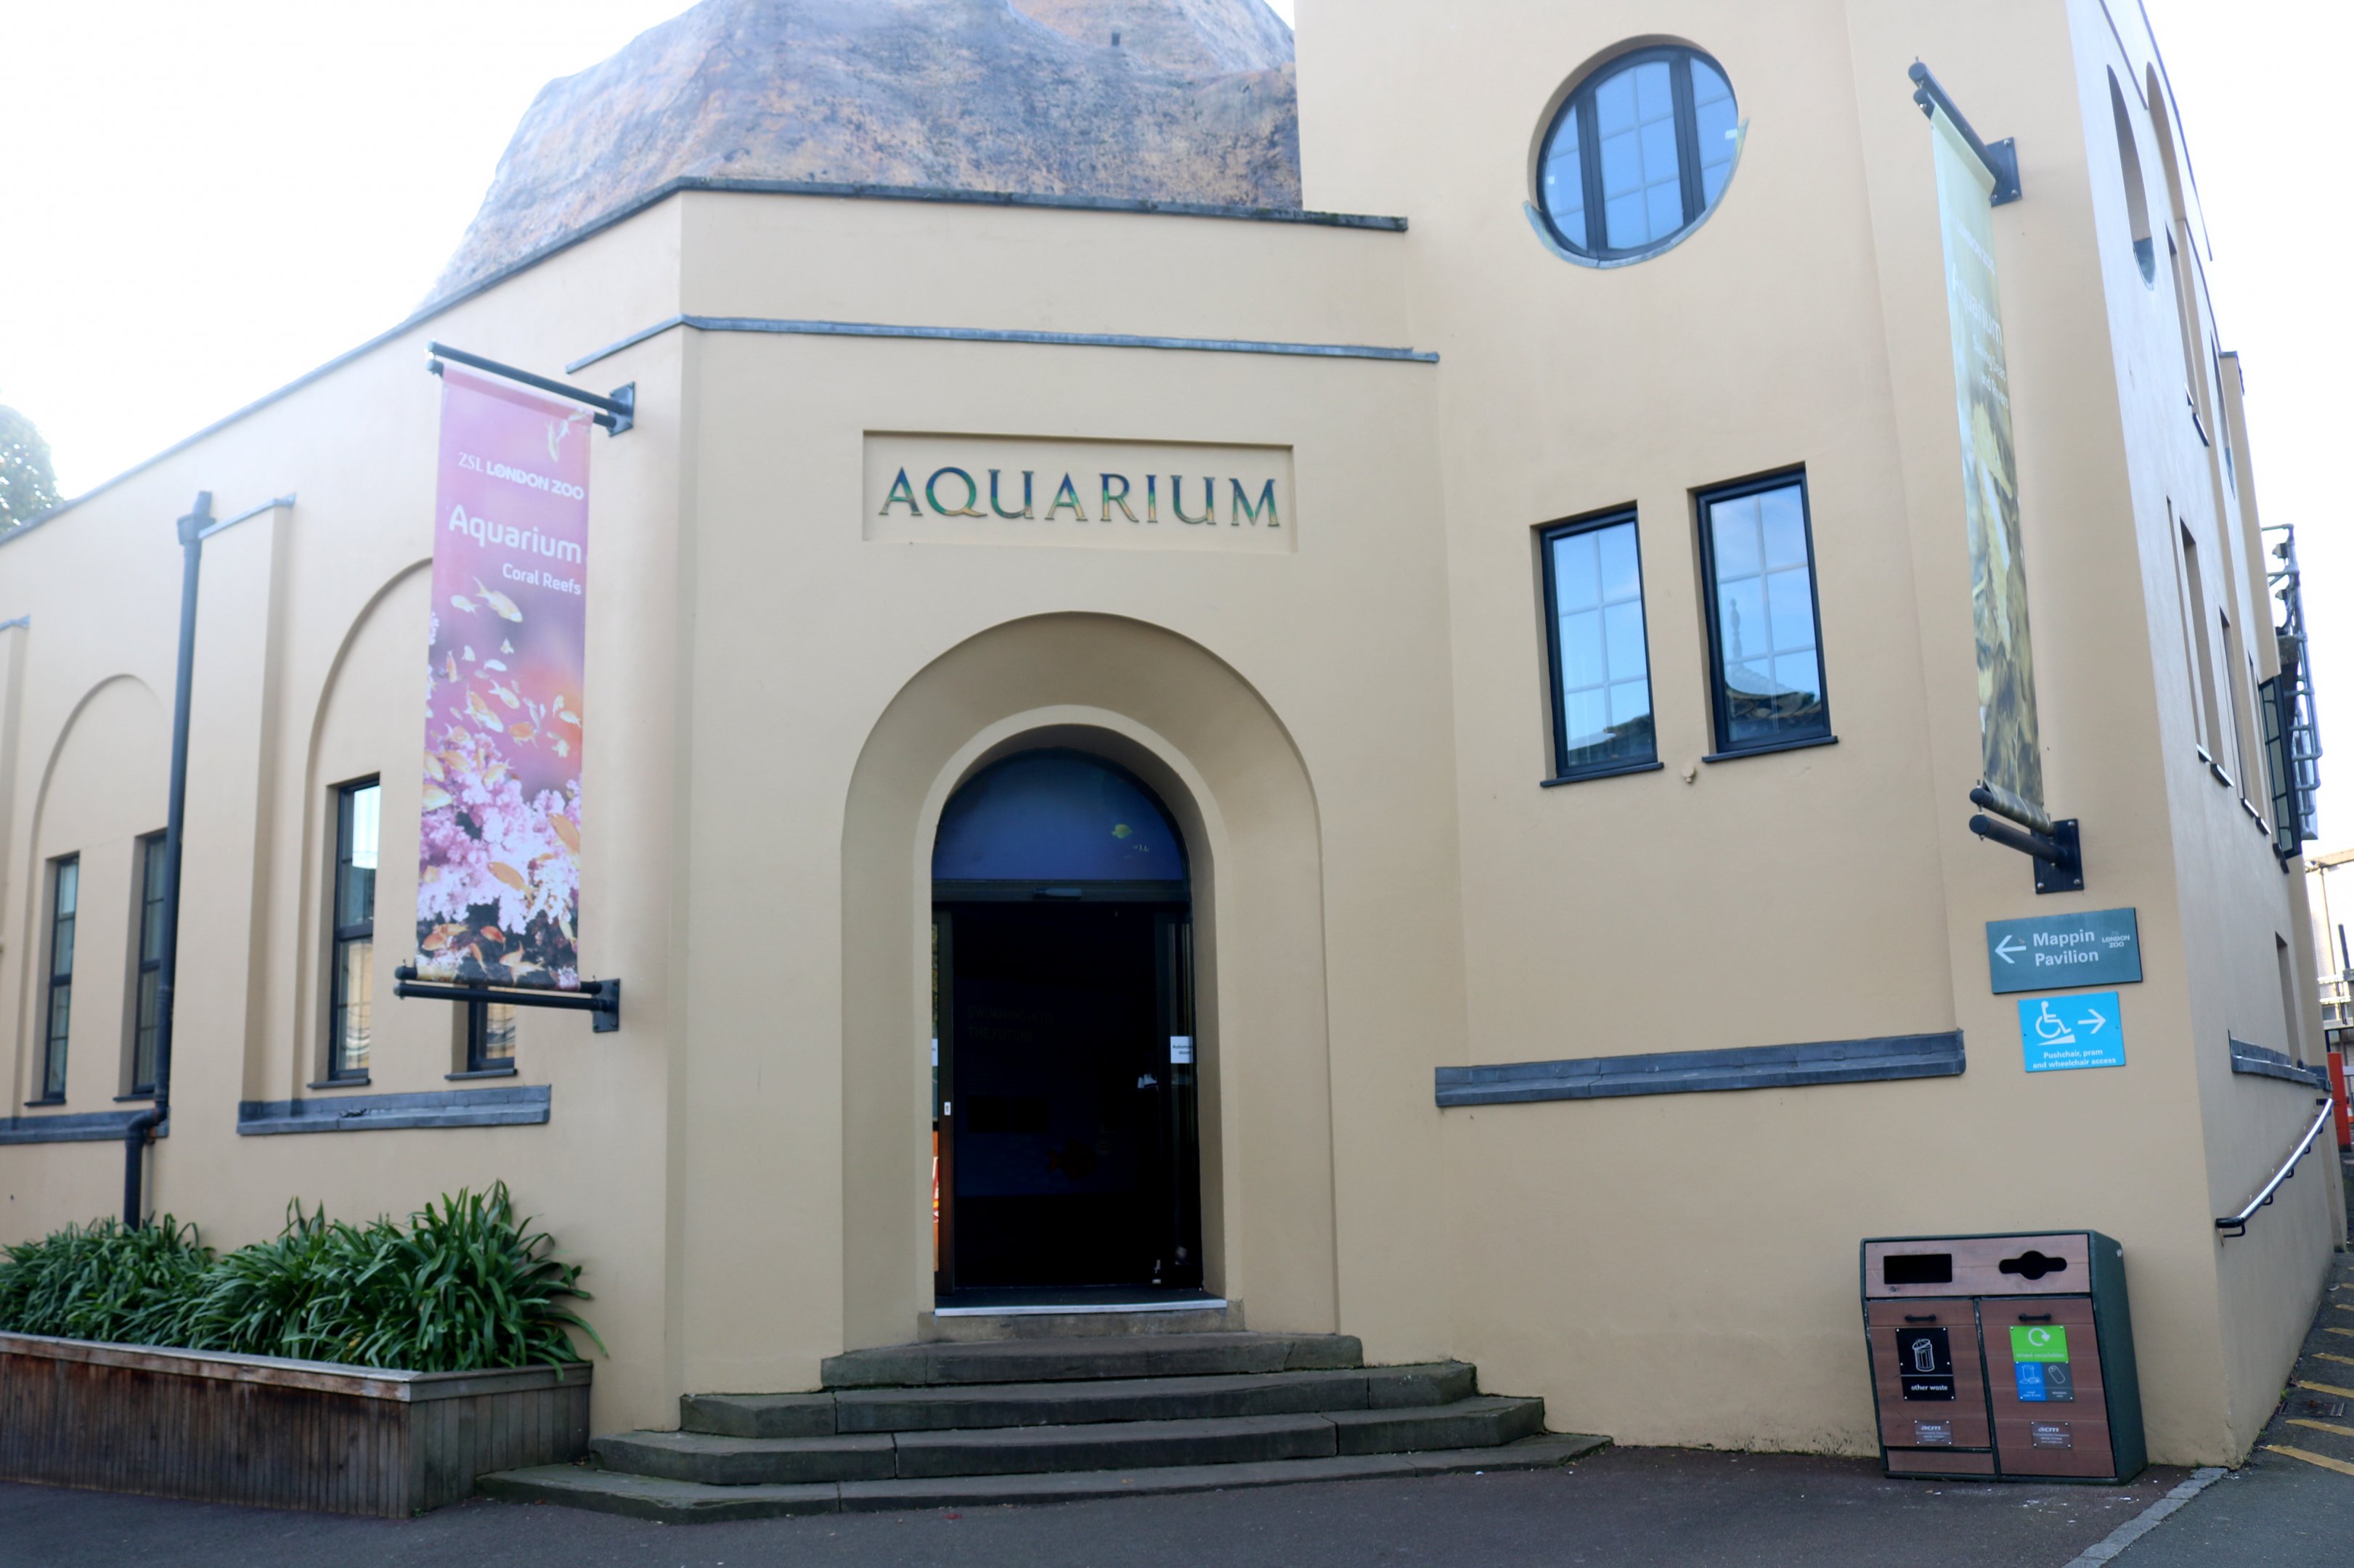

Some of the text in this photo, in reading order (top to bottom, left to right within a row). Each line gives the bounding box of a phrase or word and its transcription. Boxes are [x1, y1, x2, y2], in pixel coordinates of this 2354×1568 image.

[1952, 262, 2003, 347] Aquarium
[458, 452, 585, 500] ZSL LONDON ZOO
[878, 466, 1280, 527] AQUARIUM
[449, 504, 582, 564] Aquarium
[502, 563, 582, 595] Coral Reefs
[2032, 928, 2095, 947] Mappin
[2101, 934, 2130, 943] LONDON
[2035, 950, 2099, 967] Pavilion
[2043, 1049, 2103, 1059] Pushchair, pram
[2048, 1059, 2090, 1068] wheelchair
